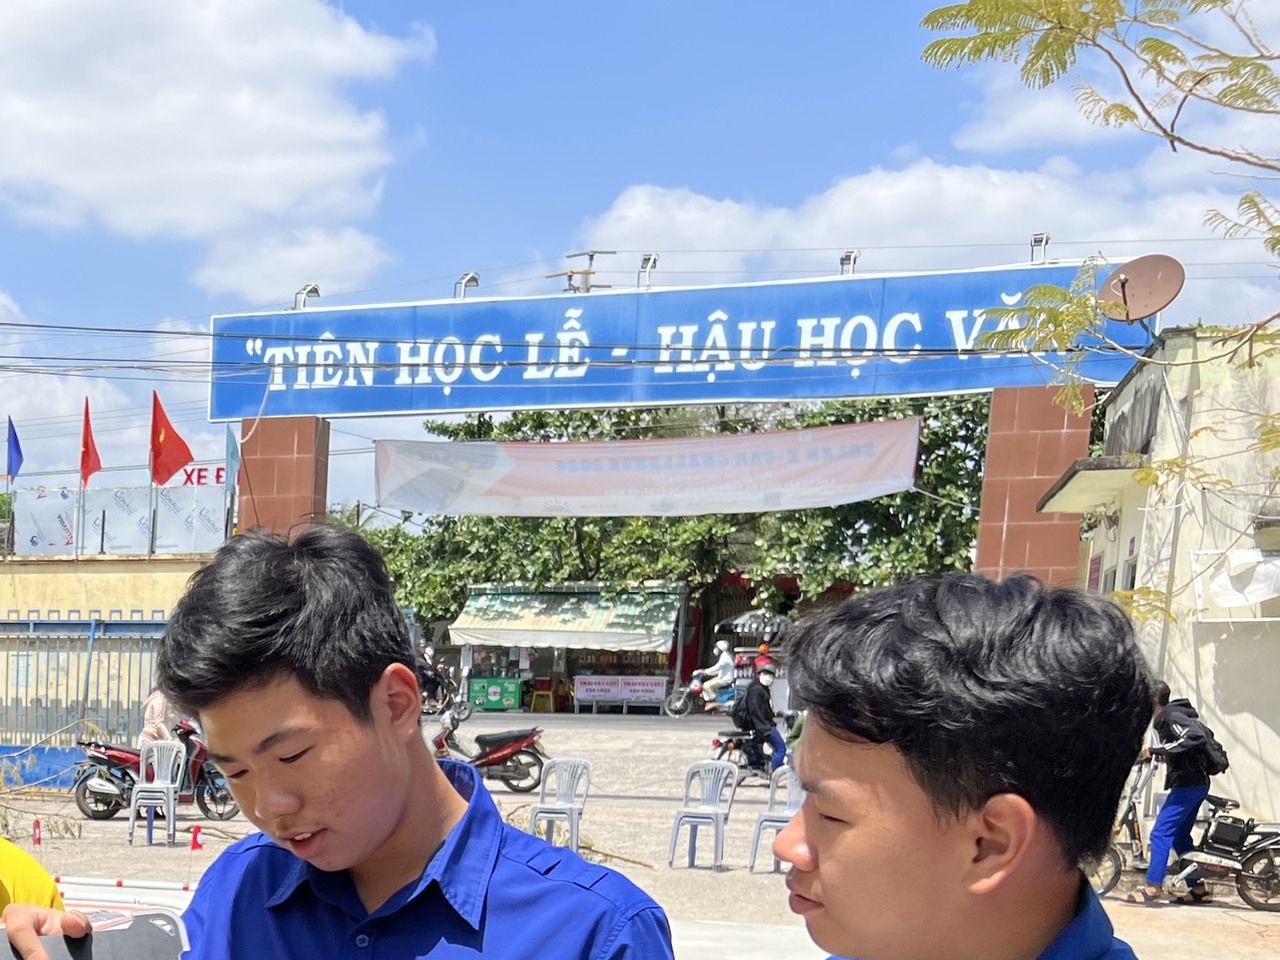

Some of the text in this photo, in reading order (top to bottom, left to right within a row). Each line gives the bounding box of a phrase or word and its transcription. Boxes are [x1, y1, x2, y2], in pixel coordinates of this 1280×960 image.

[395, 334, 503, 396] HỌC
[523, 308, 590, 380] LỄ
[654, 309, 776, 384] HẬU
[793, 312, 923, 379] HỌC
[183, 467, 208, 486] XE
